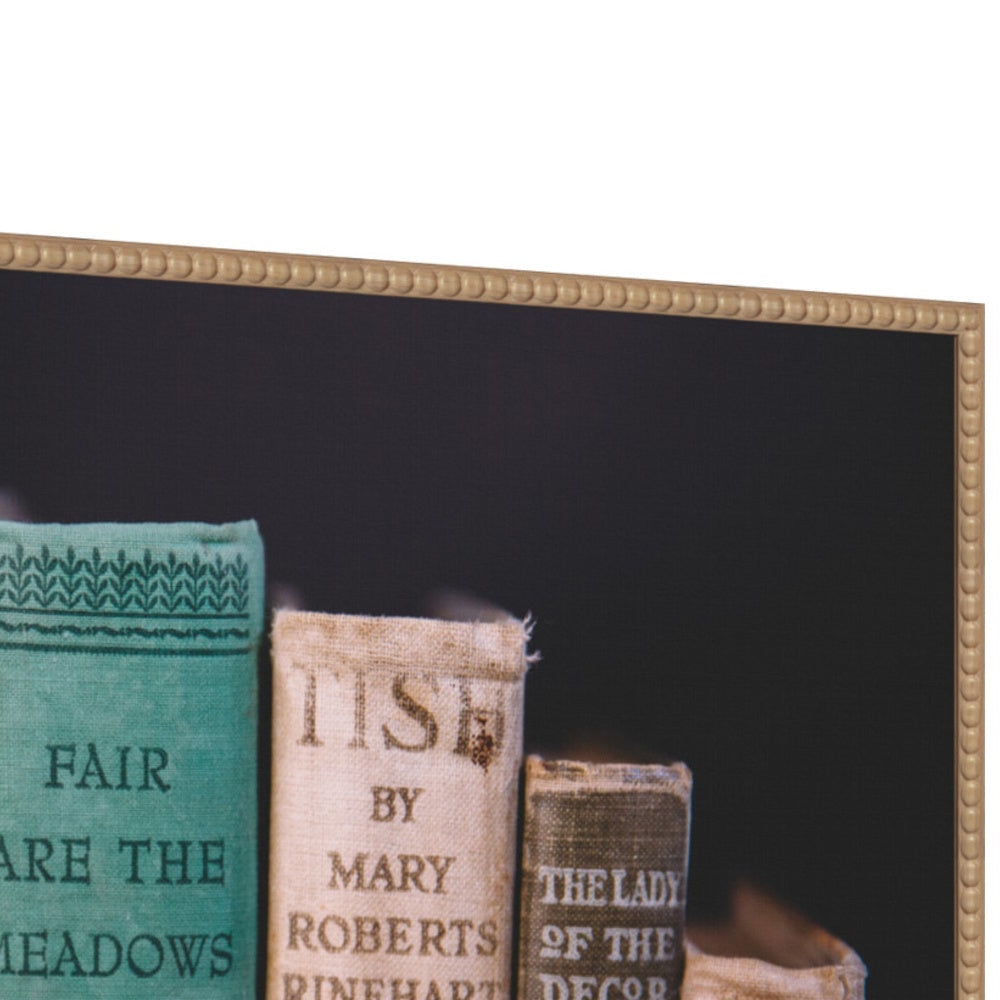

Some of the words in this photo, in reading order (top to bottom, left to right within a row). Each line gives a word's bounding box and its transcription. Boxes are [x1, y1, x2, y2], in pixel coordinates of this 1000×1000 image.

[45, 742, 171, 793] FAIR
[369, 786, 424, 823] BY
[118, 837, 226, 887] THE
[327, 850, 456, 894] MARY
[538, 865, 608, 907] THE
[611, 868, 684, 908] LADY
[287, 912, 499, 956] ROBERTS
[539, 924, 594, 961] OF
[603, 926, 675, 962] THE
